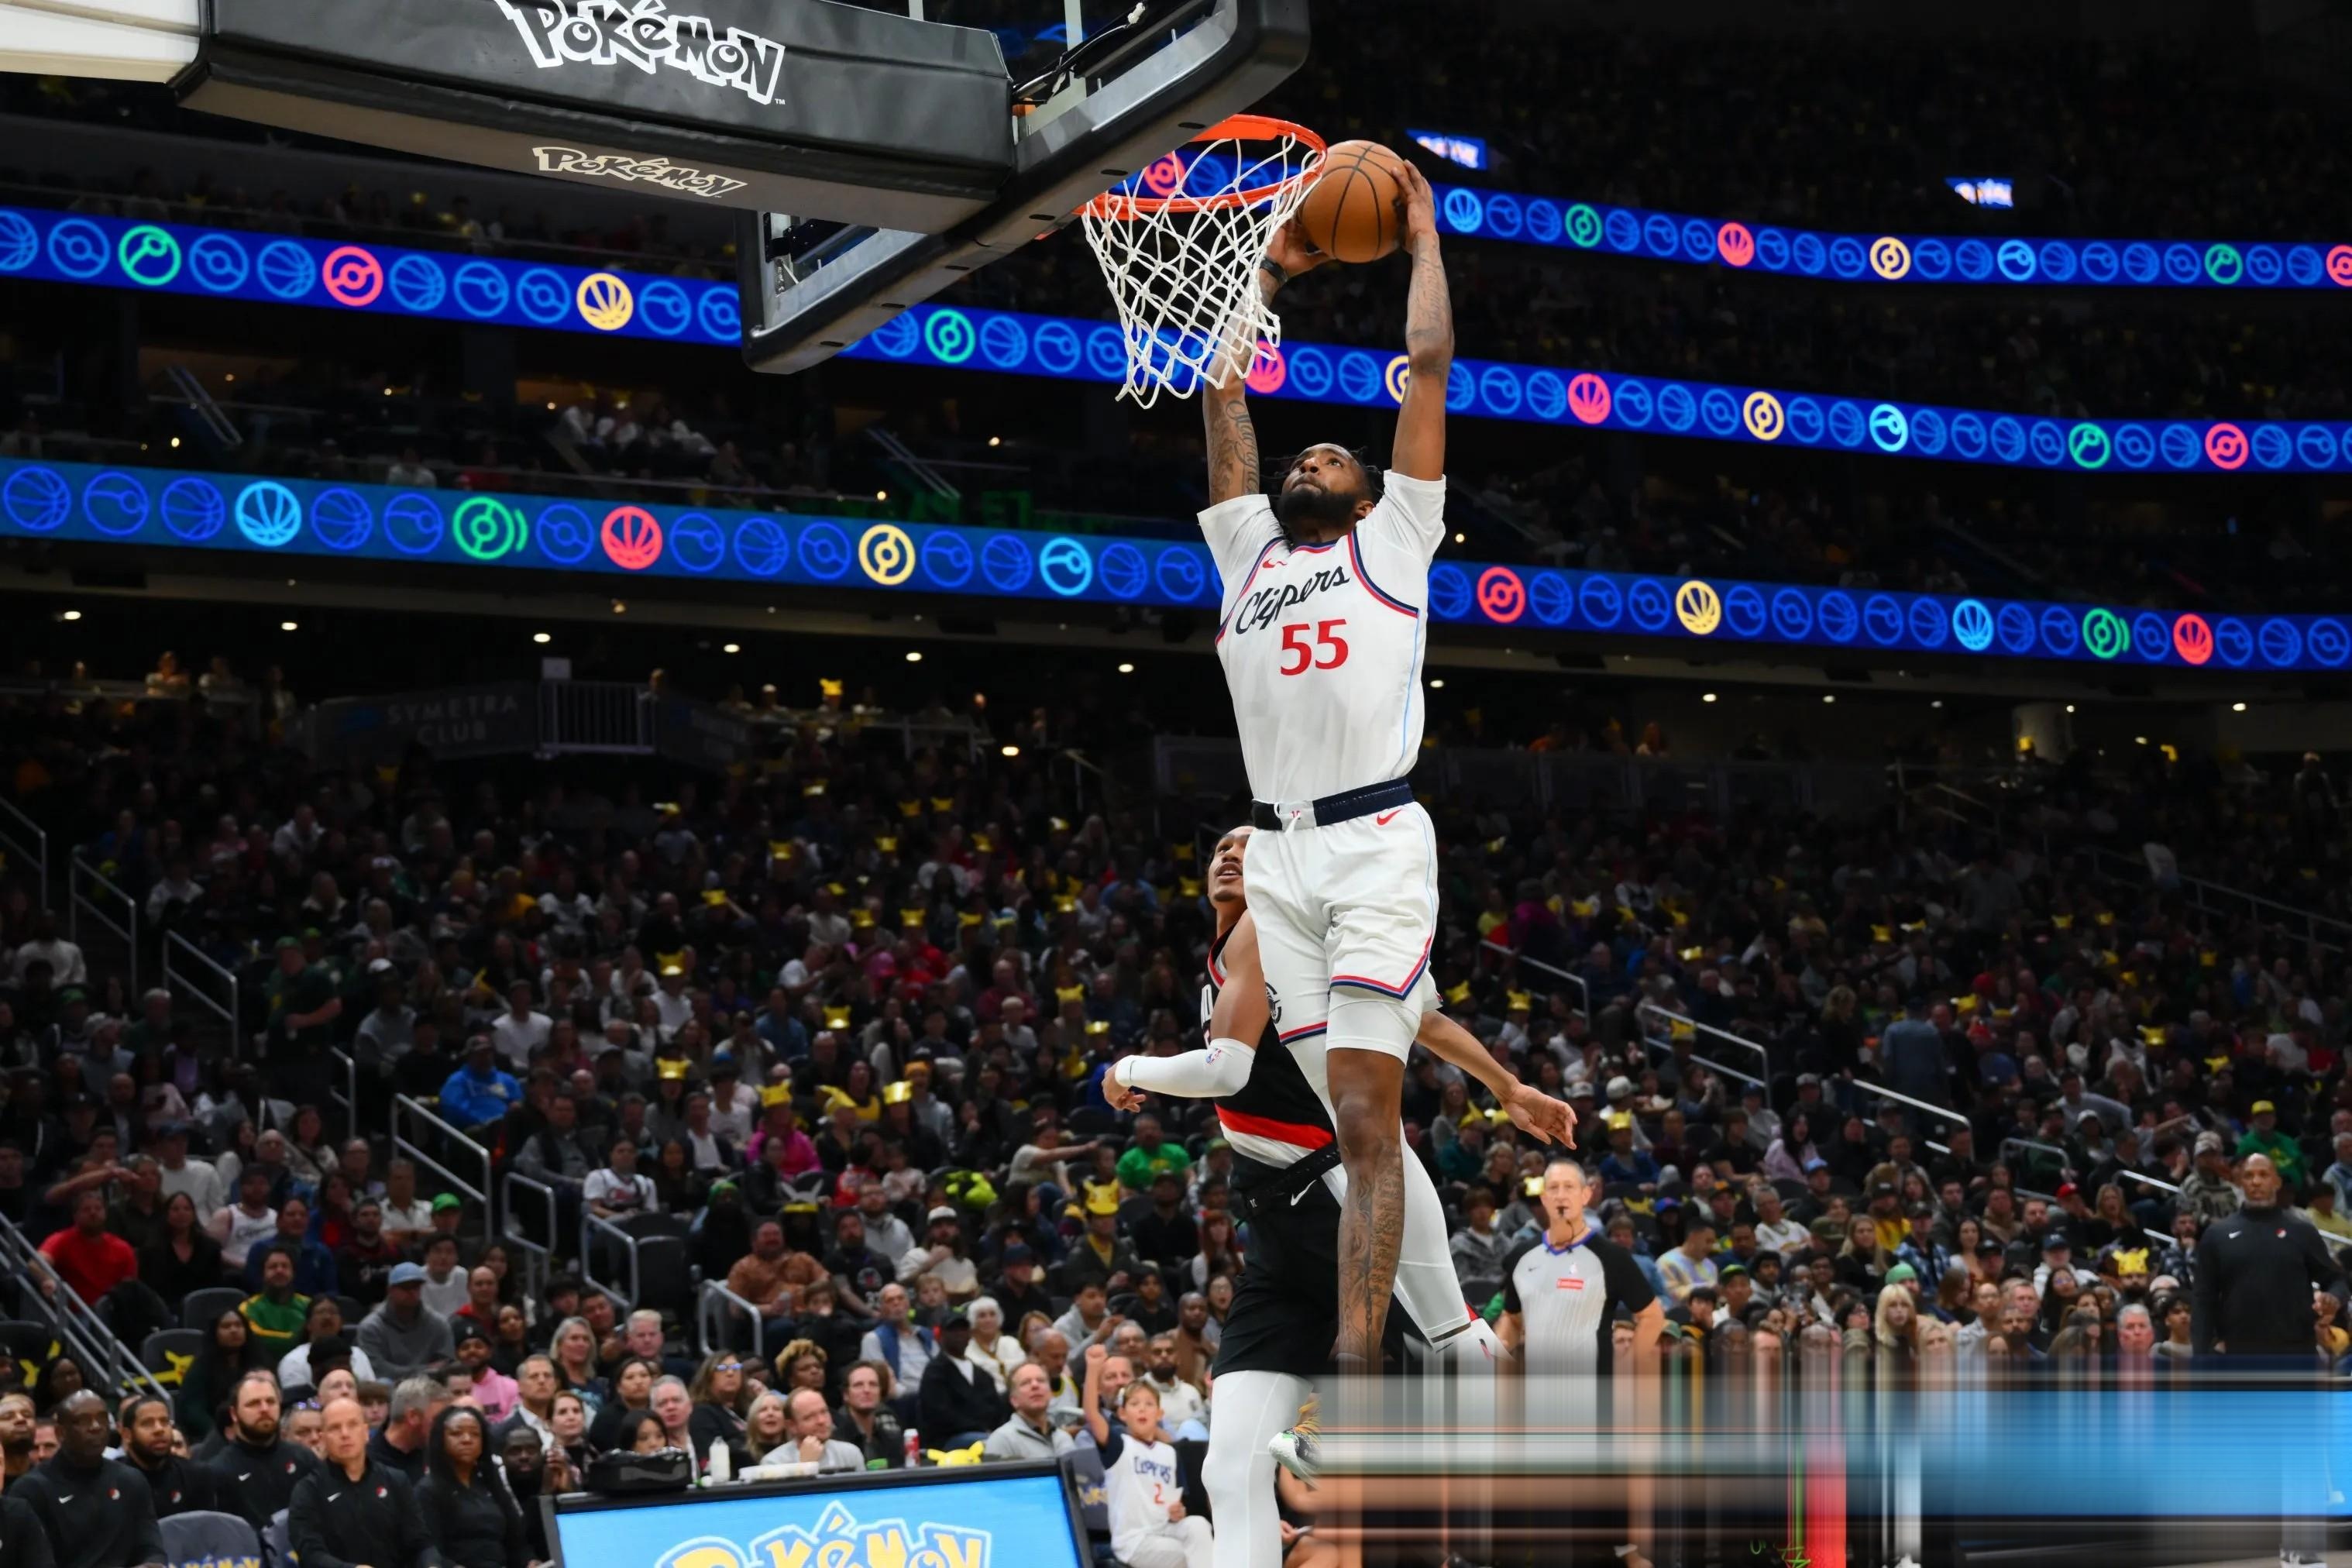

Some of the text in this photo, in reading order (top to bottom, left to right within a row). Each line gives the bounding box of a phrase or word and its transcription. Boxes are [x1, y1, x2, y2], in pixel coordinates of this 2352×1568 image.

[1280, 618, 1349, 676] 55
[387, 694, 518, 724] SYMETRA
[416, 720, 487, 747] CLUB
[1154, 1483, 1165, 1504] 2
